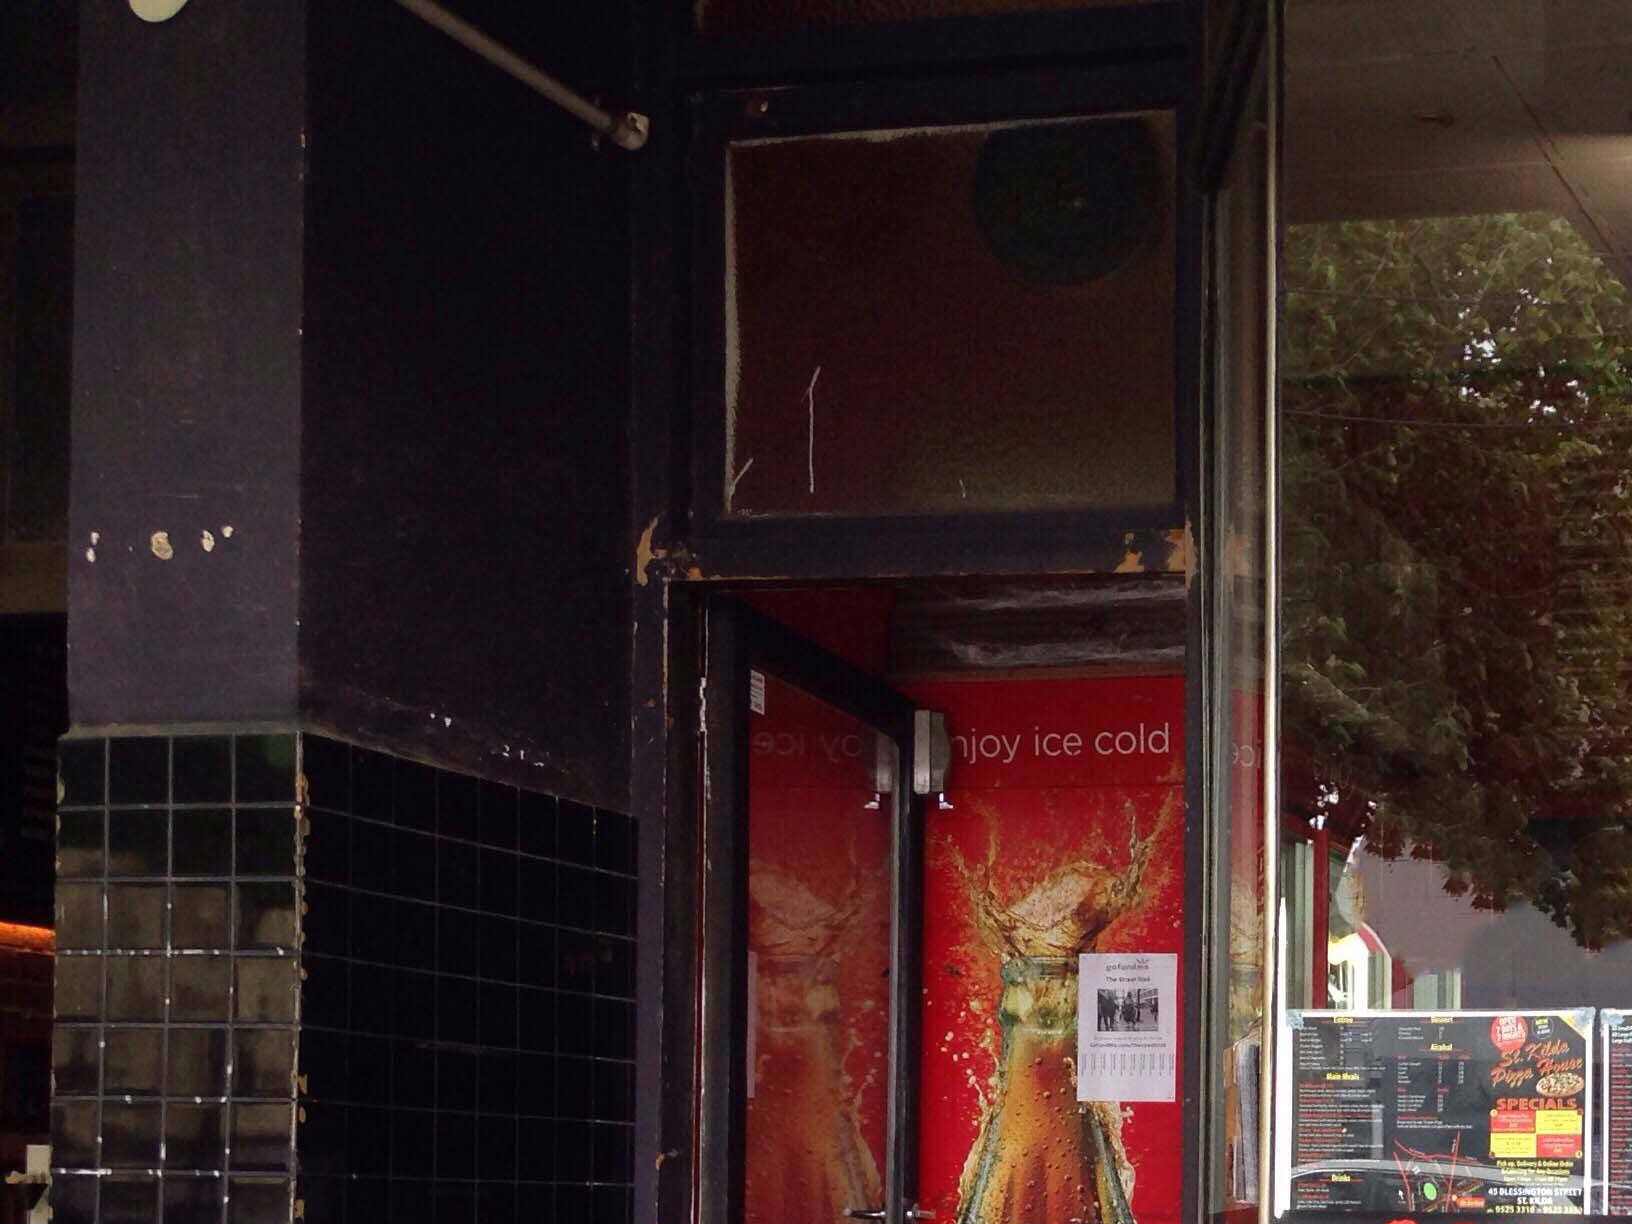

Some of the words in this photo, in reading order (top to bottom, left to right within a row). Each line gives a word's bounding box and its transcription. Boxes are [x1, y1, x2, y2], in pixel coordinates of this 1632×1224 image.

[949, 728, 1021, 765] njoy
[1034, 726, 1083, 757] ice
[1095, 722, 1170, 755] cold
[1496, 1098, 1577, 1111] SPECIALS
